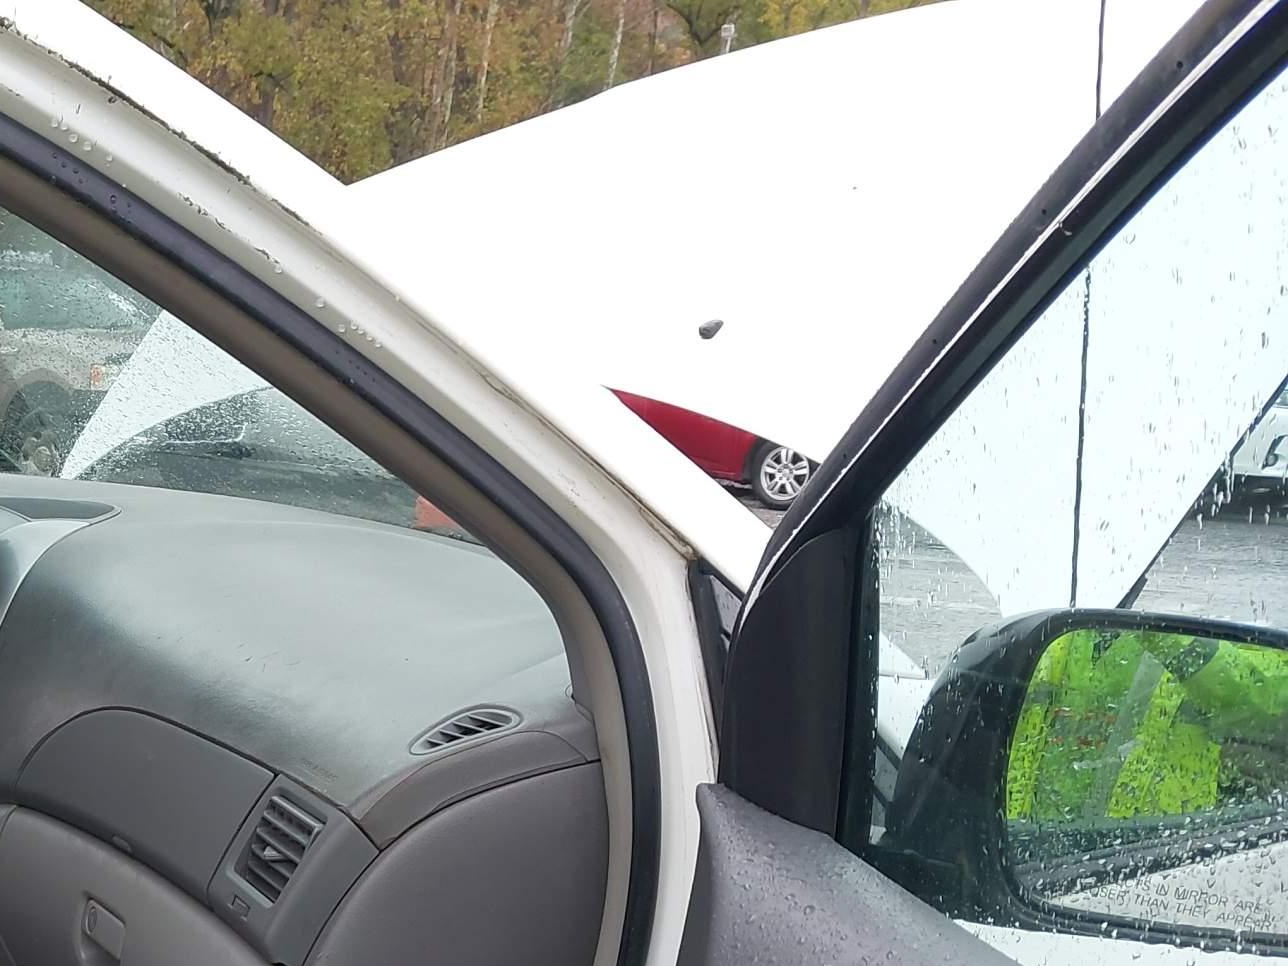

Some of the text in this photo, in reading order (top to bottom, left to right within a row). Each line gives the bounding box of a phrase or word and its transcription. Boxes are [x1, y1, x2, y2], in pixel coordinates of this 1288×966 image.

[1134, 893, 1170, 911] THAN
[1176, 902, 1211, 919] THEY
[1156, 883, 1170, 896] IN
[1174, 886, 1229, 907] MIRROR
[1234, 900, 1264, 915] ARE
